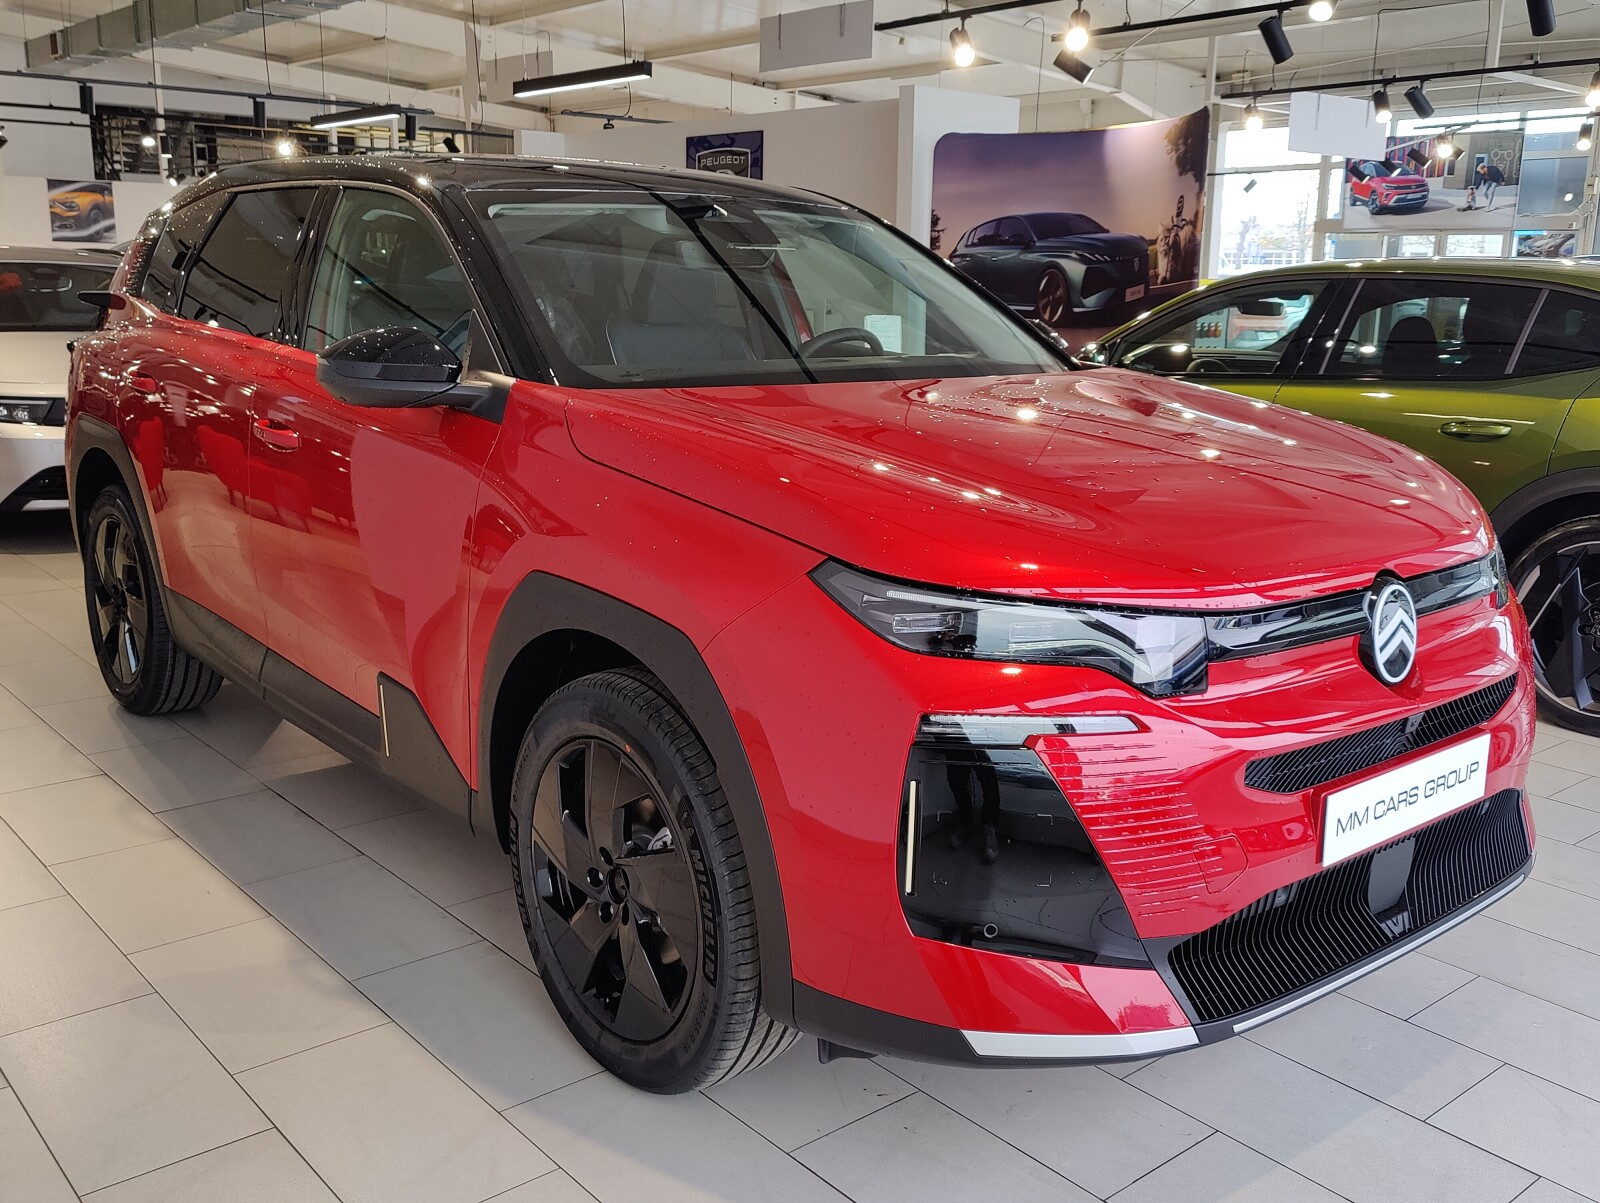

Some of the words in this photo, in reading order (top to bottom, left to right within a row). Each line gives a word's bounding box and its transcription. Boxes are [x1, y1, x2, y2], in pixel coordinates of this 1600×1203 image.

[700, 155, 746, 168] PEUGEOT
[1335, 806, 1370, 837] MM
[1373, 786, 1419, 820] CARS
[1424, 760, 1480, 799] GROUP
[510, 814, 531, 928] MICHELIN
[690, 848, 716, 981] MICHELIN
